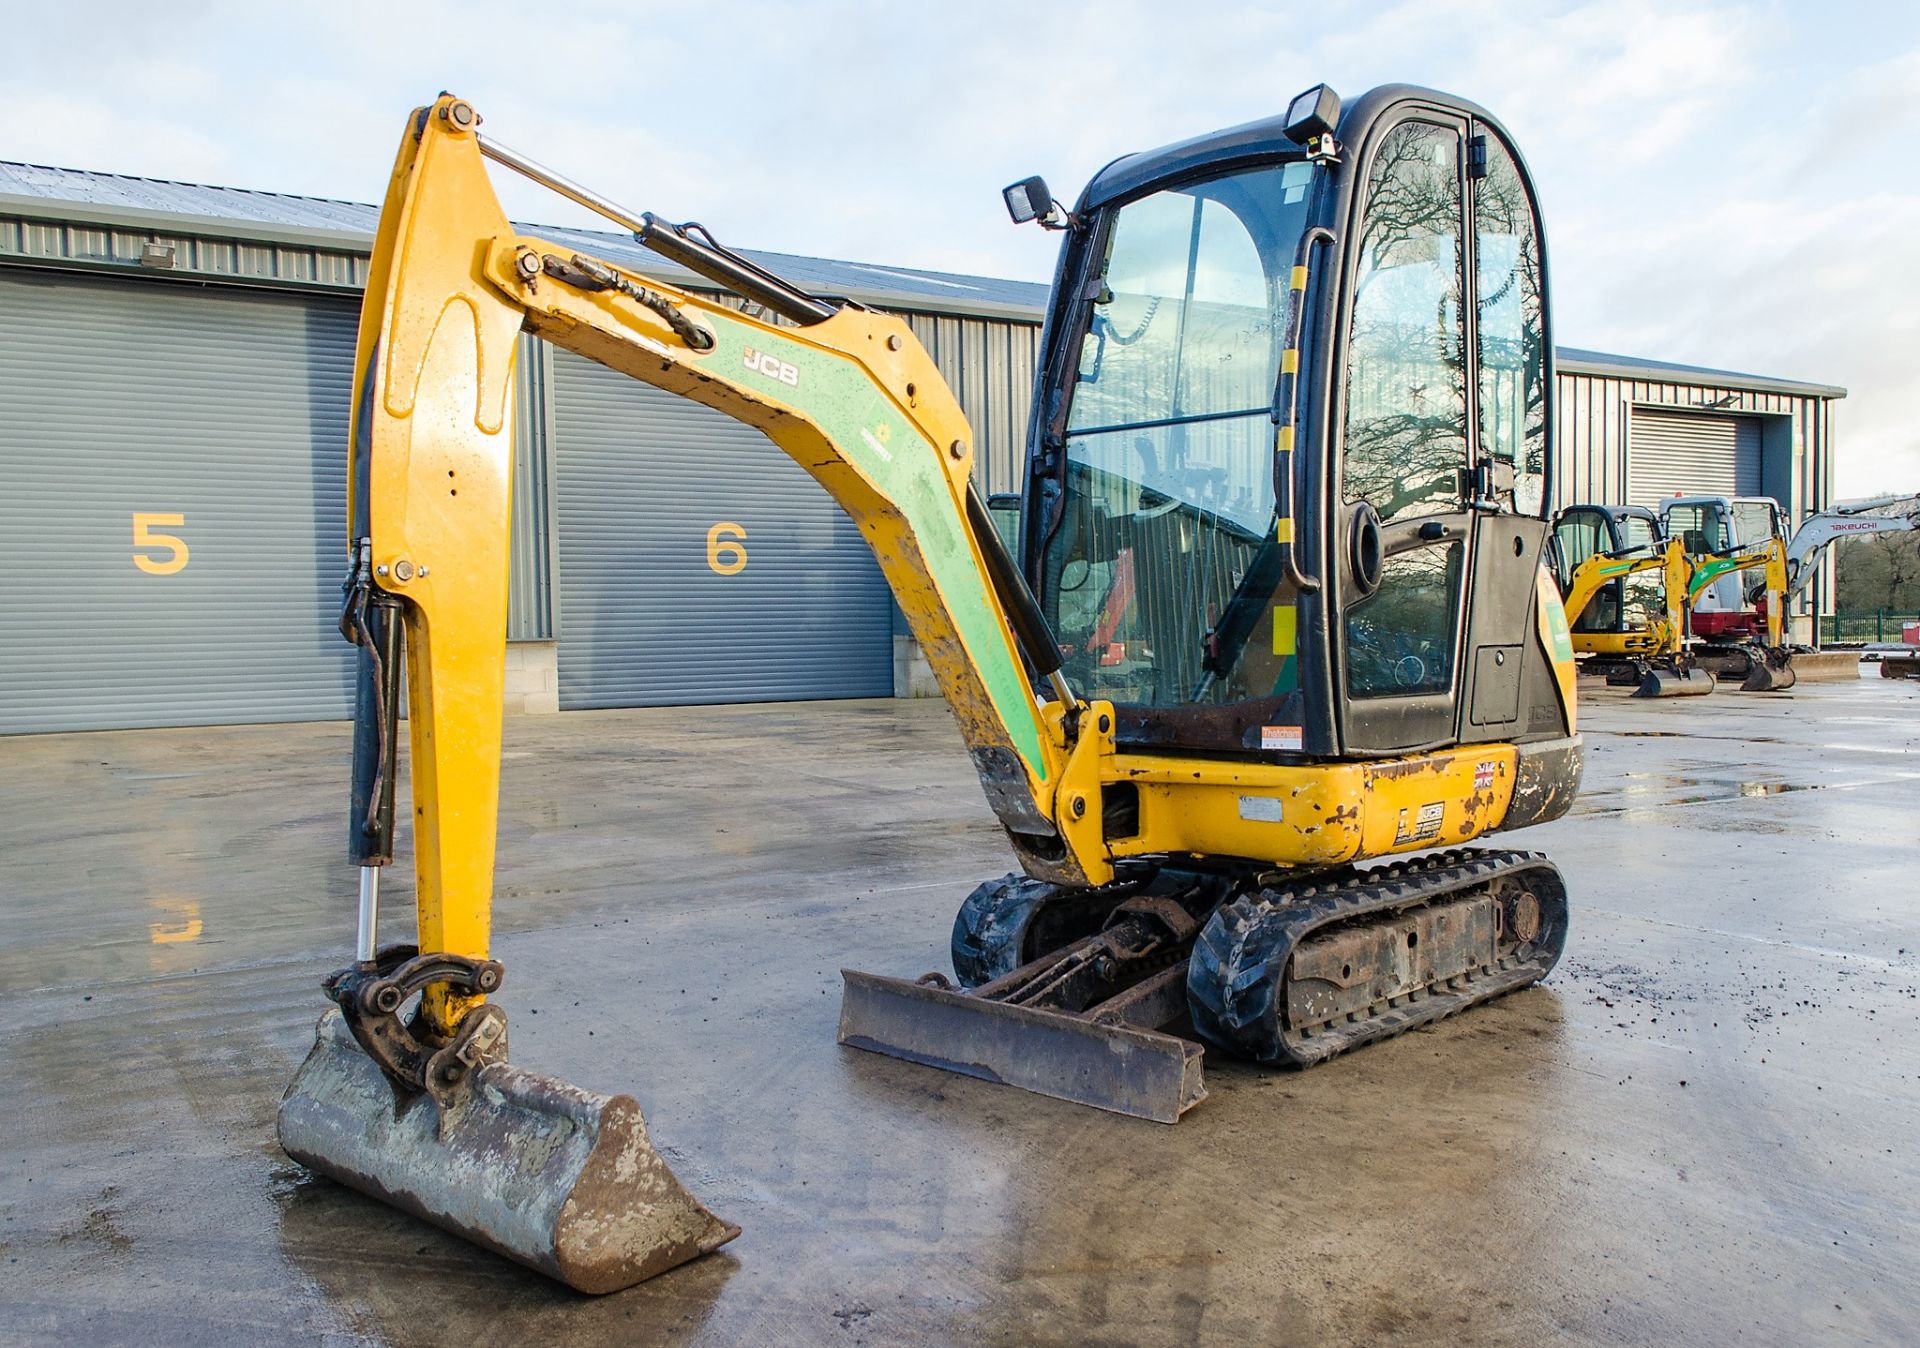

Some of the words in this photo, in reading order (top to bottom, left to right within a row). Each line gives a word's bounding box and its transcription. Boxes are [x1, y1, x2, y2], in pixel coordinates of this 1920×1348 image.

[743, 346, 799, 387] JCB
[133, 513, 188, 574] 5
[707, 522, 747, 575] 6
[1263, 728, 1301, 739] Thatcham
